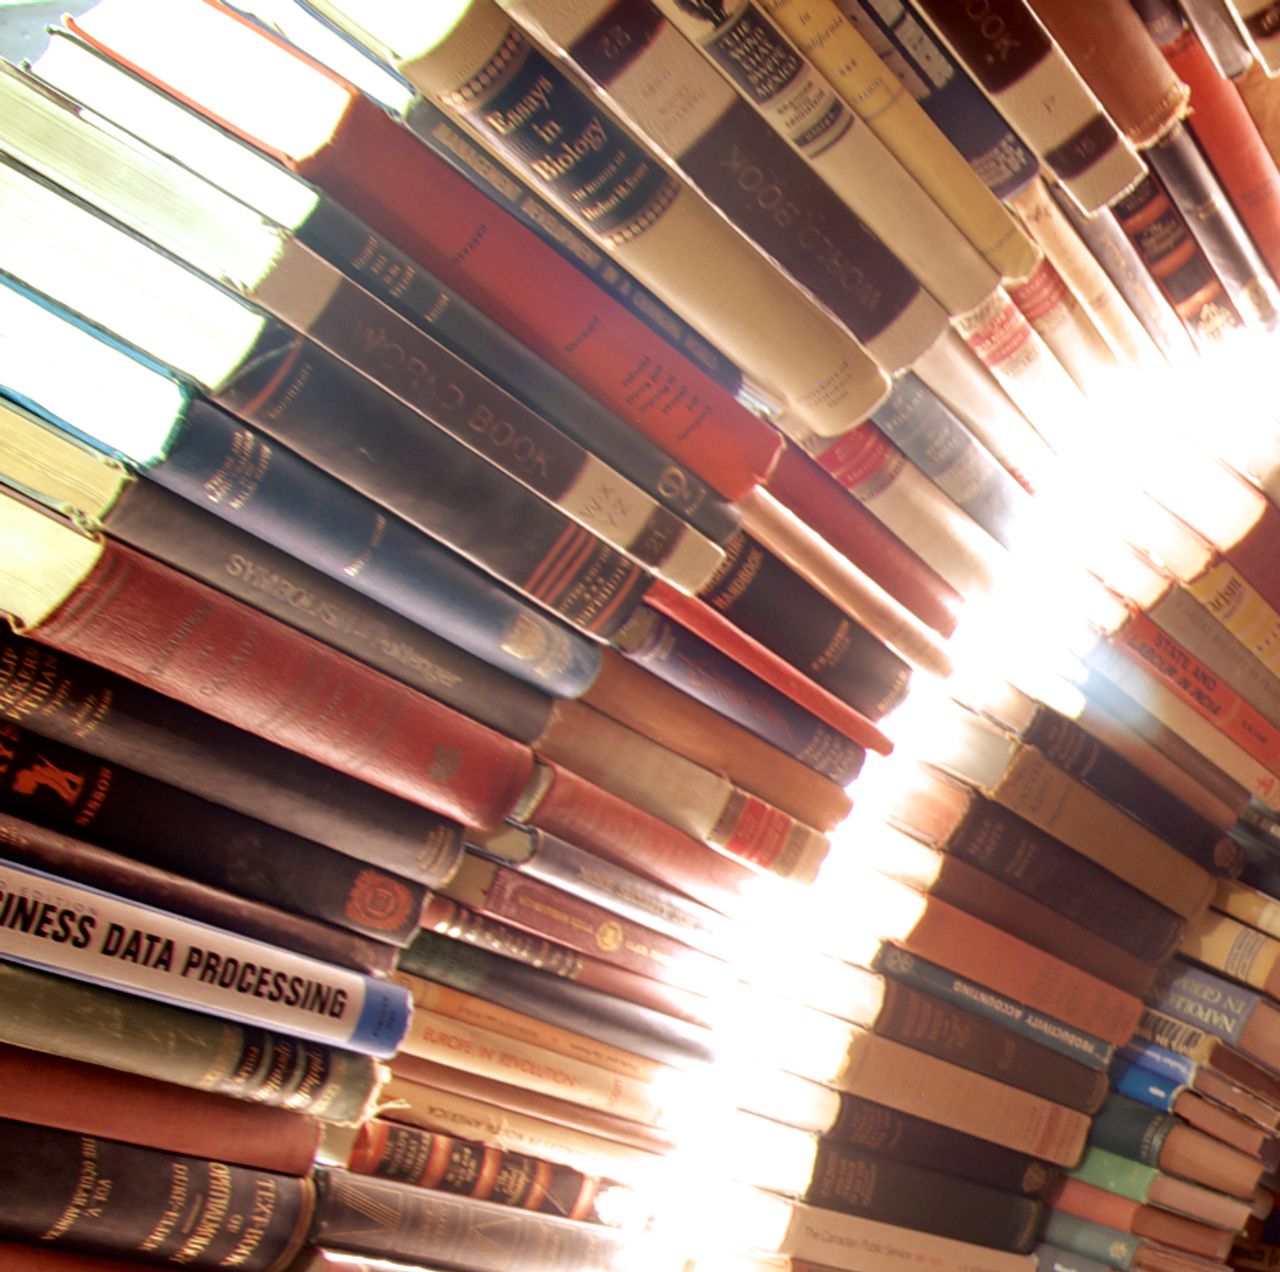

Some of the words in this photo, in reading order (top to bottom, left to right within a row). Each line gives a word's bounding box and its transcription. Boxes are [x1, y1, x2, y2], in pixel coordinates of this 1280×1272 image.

[488, 72, 557, 139] Essays
[533, 115, 562, 143] in
[535, 113, 609, 186] Biology
[722, 146, 799, 224] BOOK
[600, 263, 621, 284] IN
[471, 407, 553, 475] BOOK
[714, 552, 763, 606] HANDBOOK
[1128, 635, 1171, 674] LABOUR
[1170, 670, 1191, 691] IN
[1189, 686, 1221, 716] INDIA
[1151, 634, 1189, 668] STATE
[1188, 665, 1217, 692] AND
[102, 924, 176, 971] DATA
[185, 947, 345, 1016] PROCESSING
[954, 980, 1020, 1018] ACCOUNTING
[1222, 994, 1244, 1015] IN
[422, 1027, 472, 1053] EUROPE
[478, 1044, 499, 1060] IN
[497, 1051, 578, 1086] REVOLUTION
[67, 1159, 96, 1202] OCULAR
[225, 1212, 242, 1233] OF
[803, 1228, 820, 1241] The
